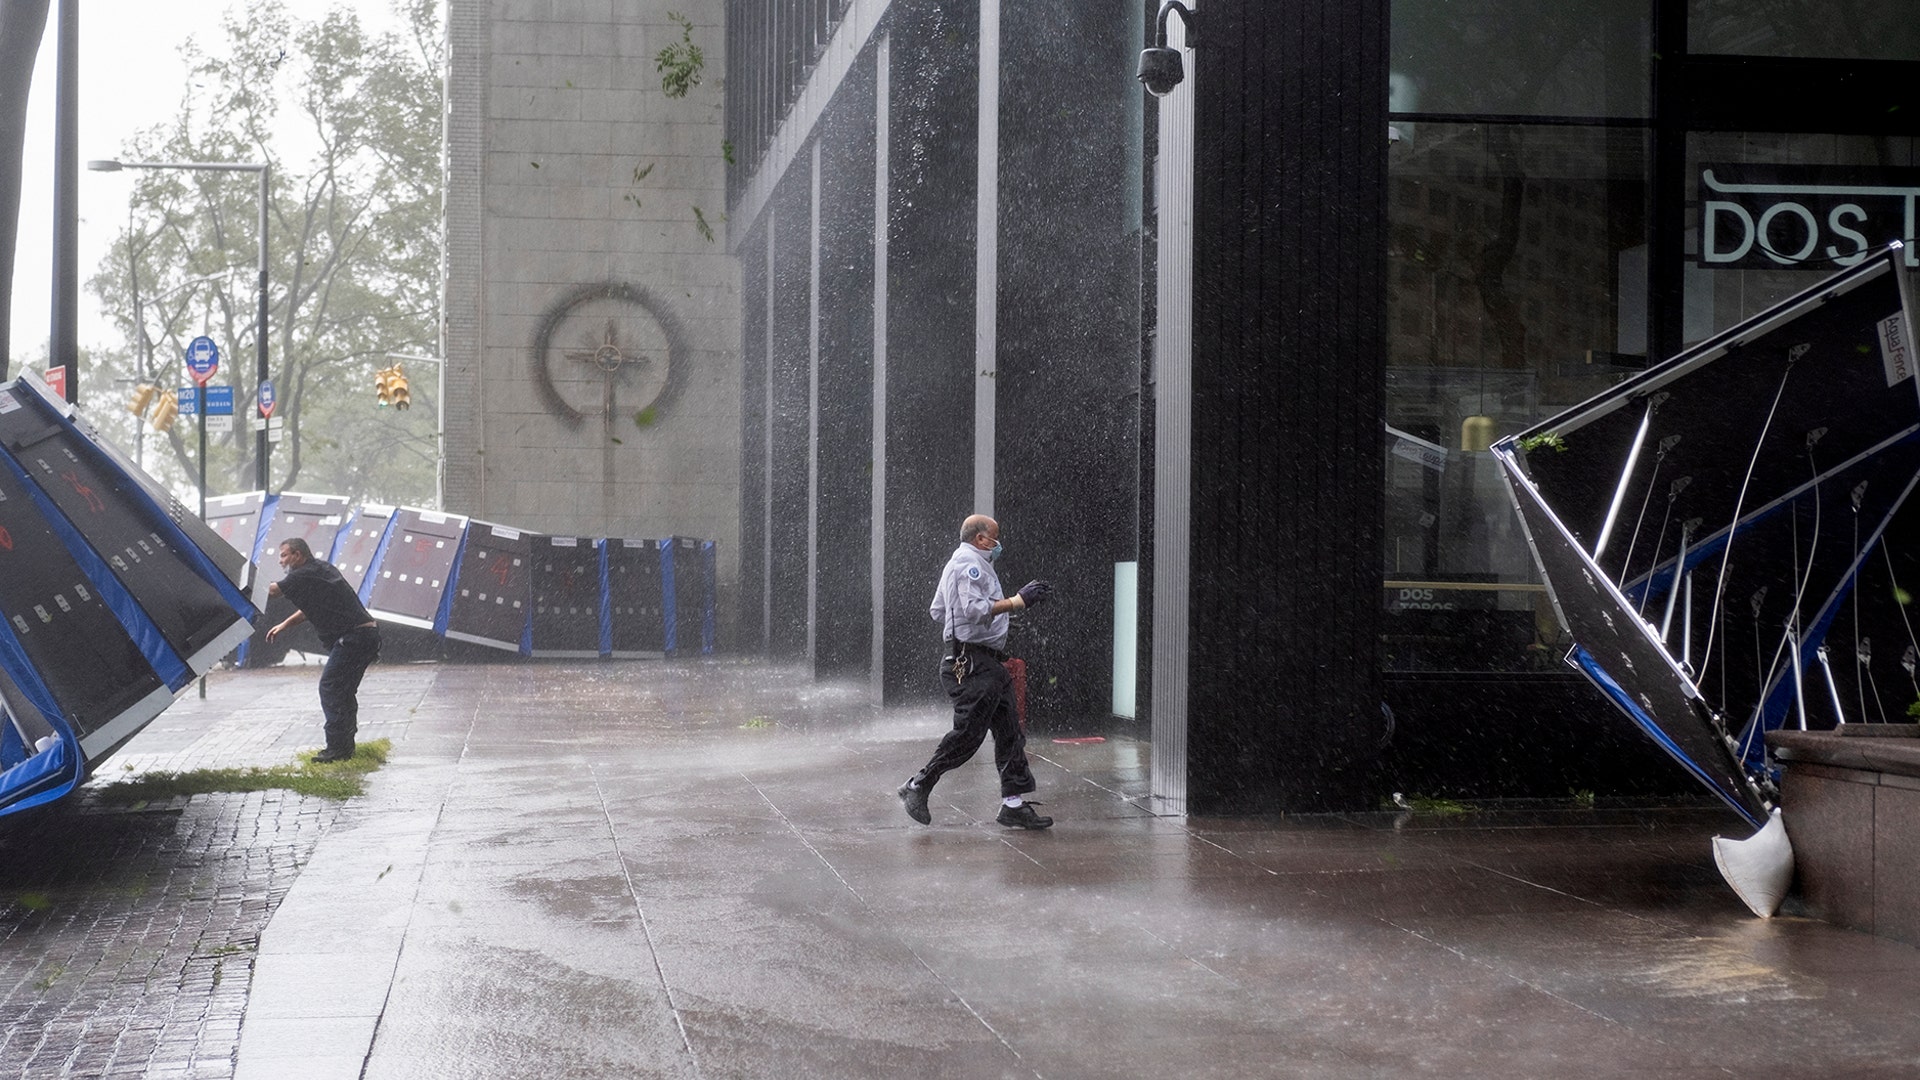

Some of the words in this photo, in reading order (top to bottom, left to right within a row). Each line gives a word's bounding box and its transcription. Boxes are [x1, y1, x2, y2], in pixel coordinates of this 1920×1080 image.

[1704, 201, 1868, 266] DOS
[1883, 317, 1907, 380] AquaFence
[179, 389, 195, 400] M20
[179, 402, 195, 413] M55
[1400, 588, 1434, 600] DOS
